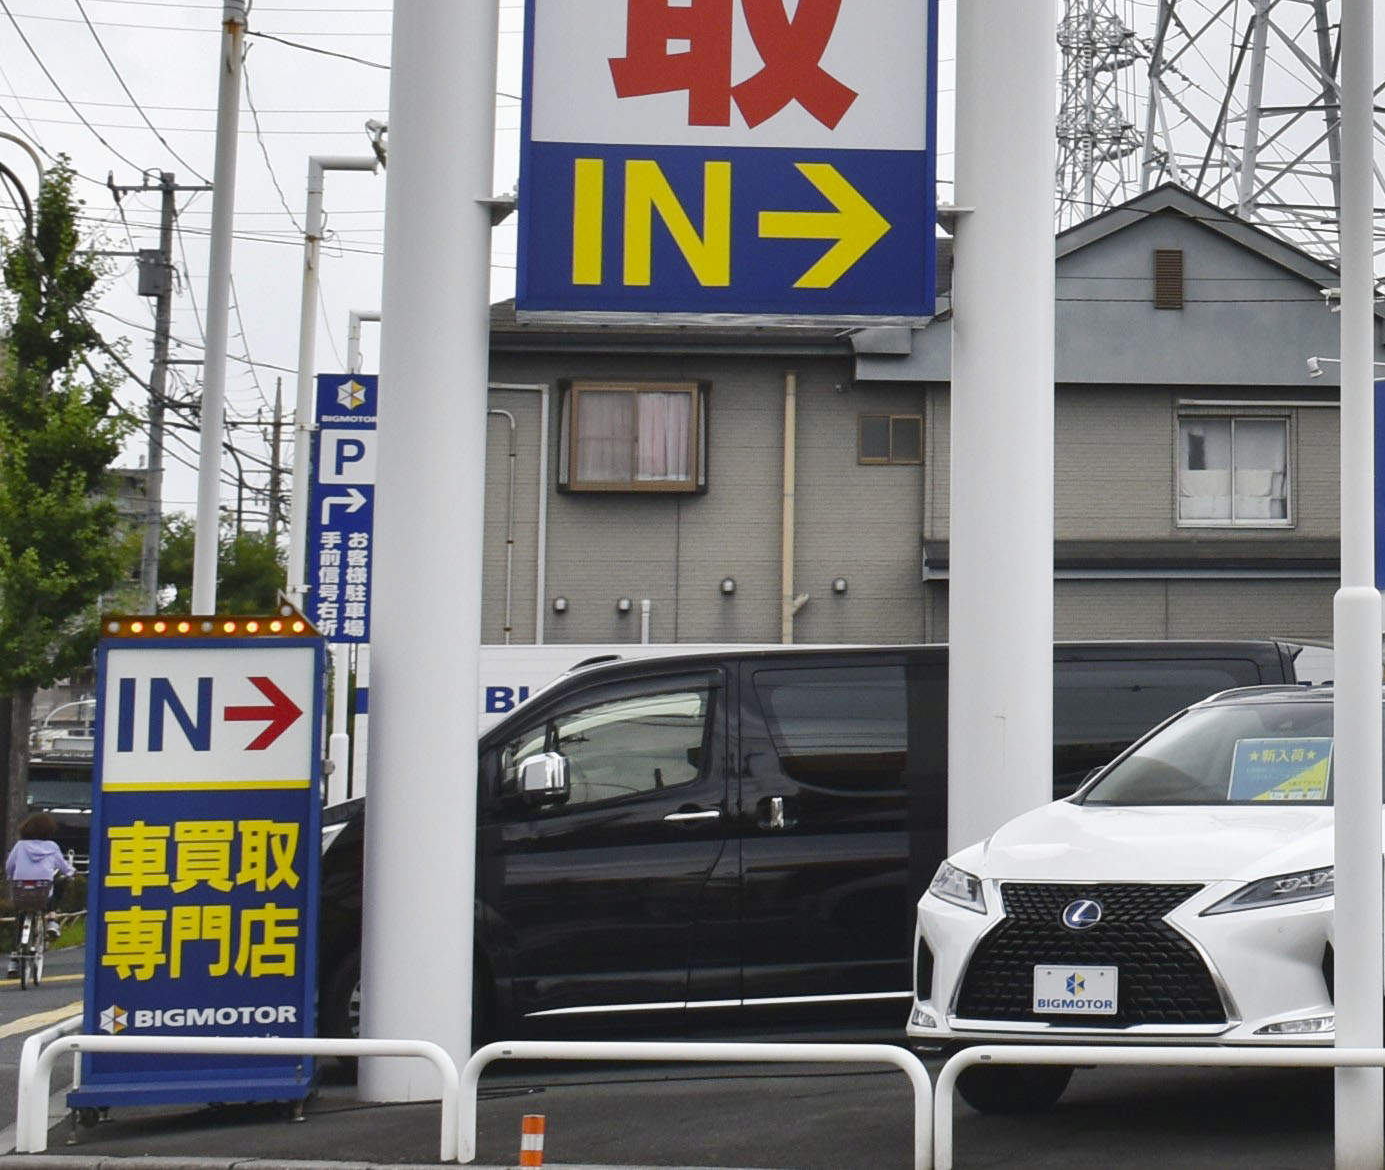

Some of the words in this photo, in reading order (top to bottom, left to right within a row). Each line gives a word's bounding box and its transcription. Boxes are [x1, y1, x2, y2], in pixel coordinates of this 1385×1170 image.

[571, 157, 732, 288] IN
[335, 438, 366, 476] P
[316, 531, 342, 637] 手前信号右折
[343, 532, 369, 637] お客様駐車場
[117, 677, 214, 752] IN
[104, 819, 300, 896] 車買取
[101, 902, 300, 981] 専門店
[134, 1006, 297, 1028] BIGMOTOR
[1037, 998, 1113, 1009] BIGMOTOR
